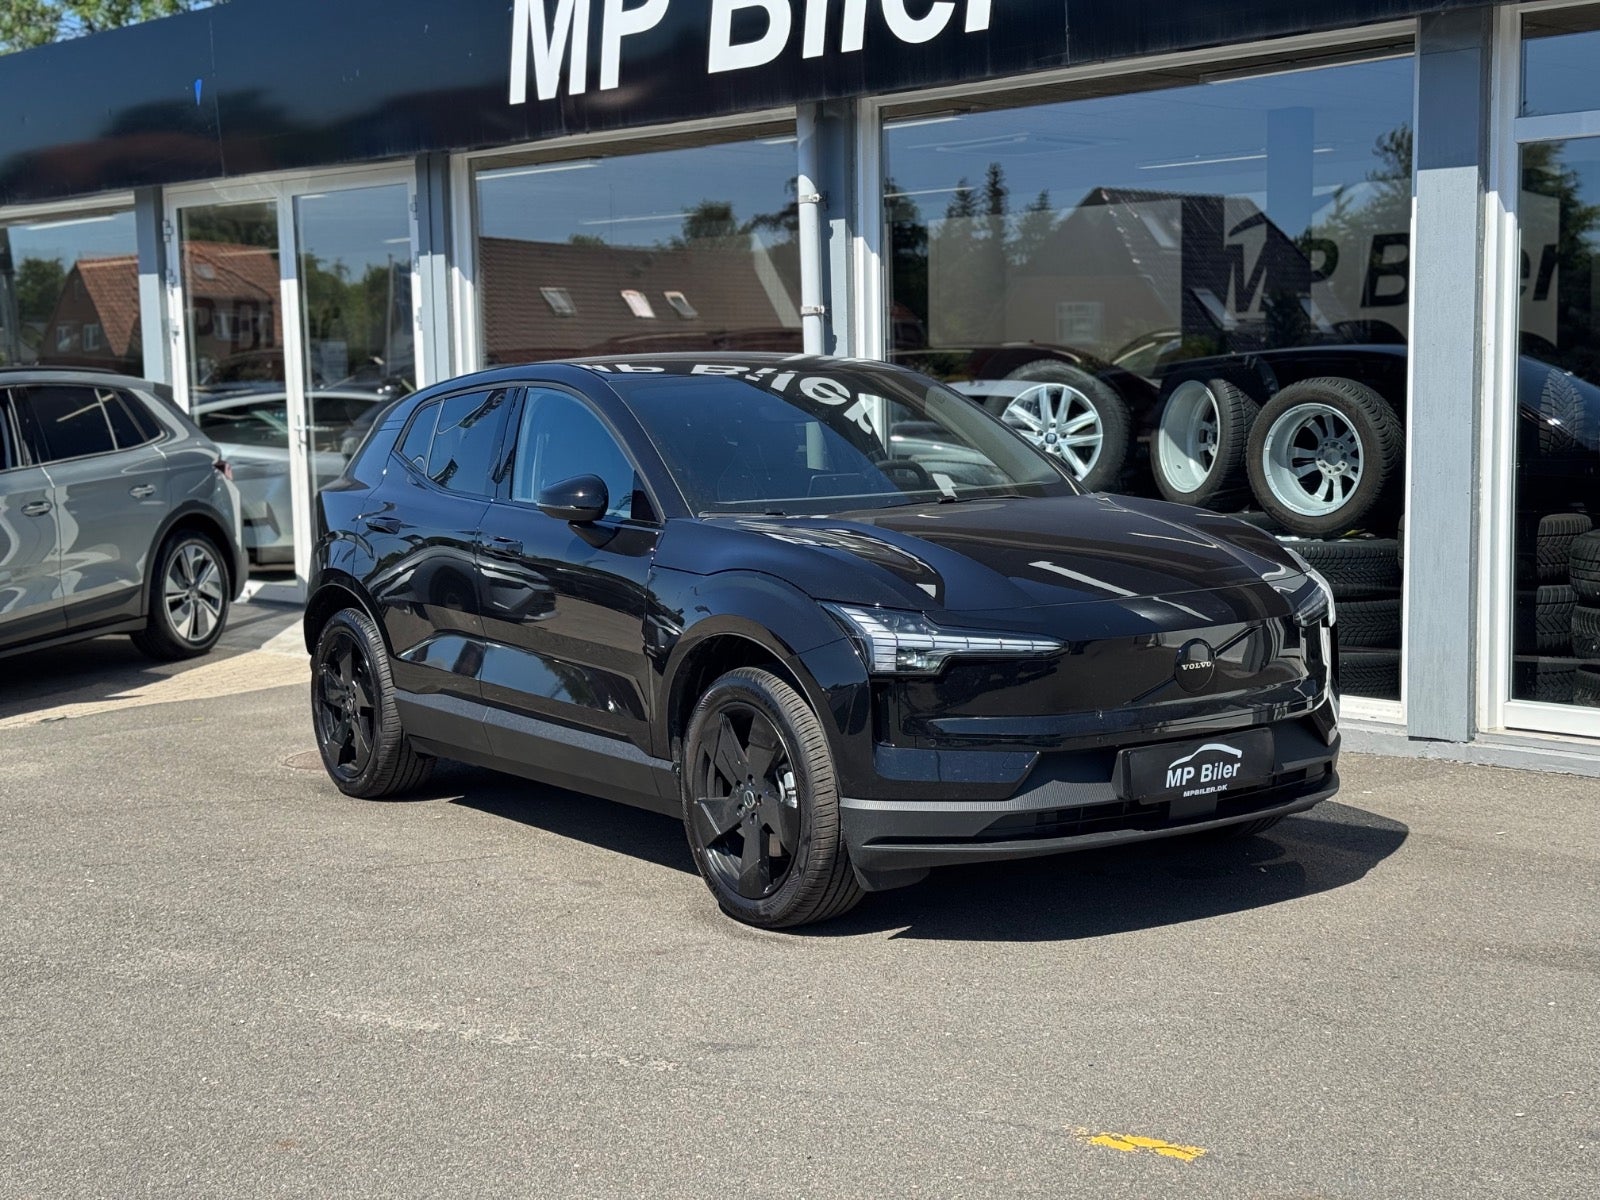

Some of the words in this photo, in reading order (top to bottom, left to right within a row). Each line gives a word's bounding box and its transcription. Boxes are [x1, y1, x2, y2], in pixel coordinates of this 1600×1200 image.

[509, 0, 669, 105] MP
[1181, 661, 1212, 670] VOLVO
[1165, 766, 1195, 788] MP
[1200, 761, 1241, 782] Biler
[1183, 784, 1228, 797] MPBILER.DK
